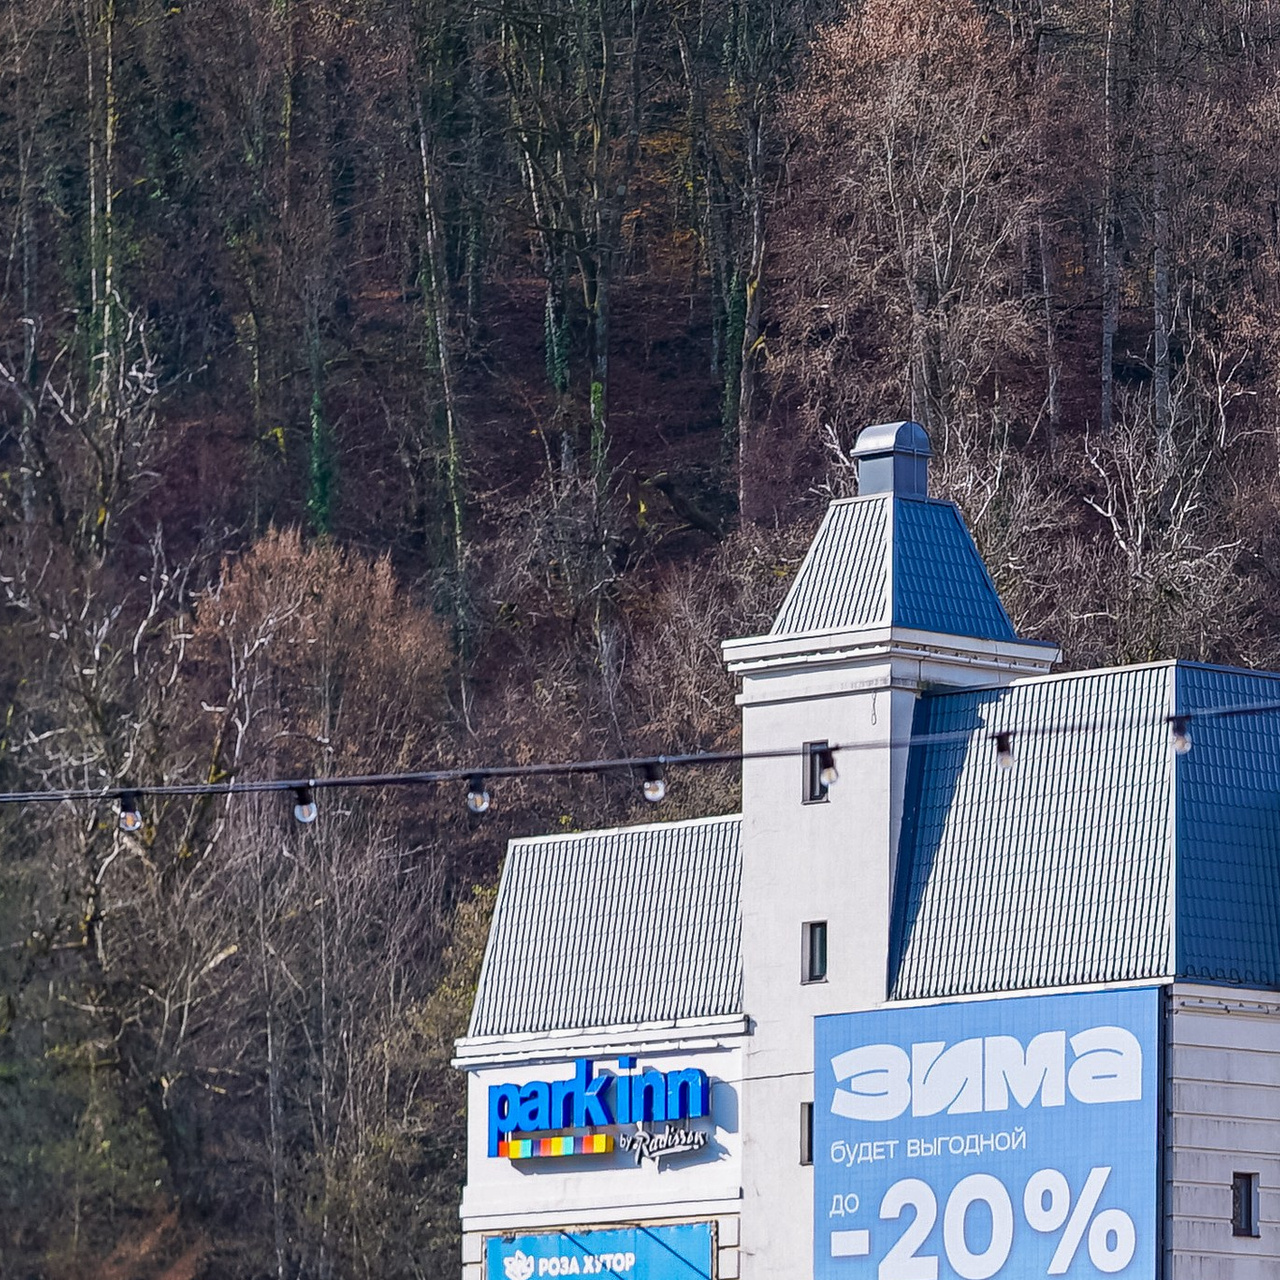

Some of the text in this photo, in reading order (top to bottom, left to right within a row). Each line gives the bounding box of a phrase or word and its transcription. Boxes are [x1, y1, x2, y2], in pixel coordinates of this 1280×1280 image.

[488, 1056, 711, 1158] park inn
[620, 1124, 708, 1165] by Radisson
[907, 1126, 1026, 1157] ВЫГОДНОЙ
[829, 1193, 860, 1218] ДО
[538, 1252, 636, 1277] РОЗА ХУТОР
